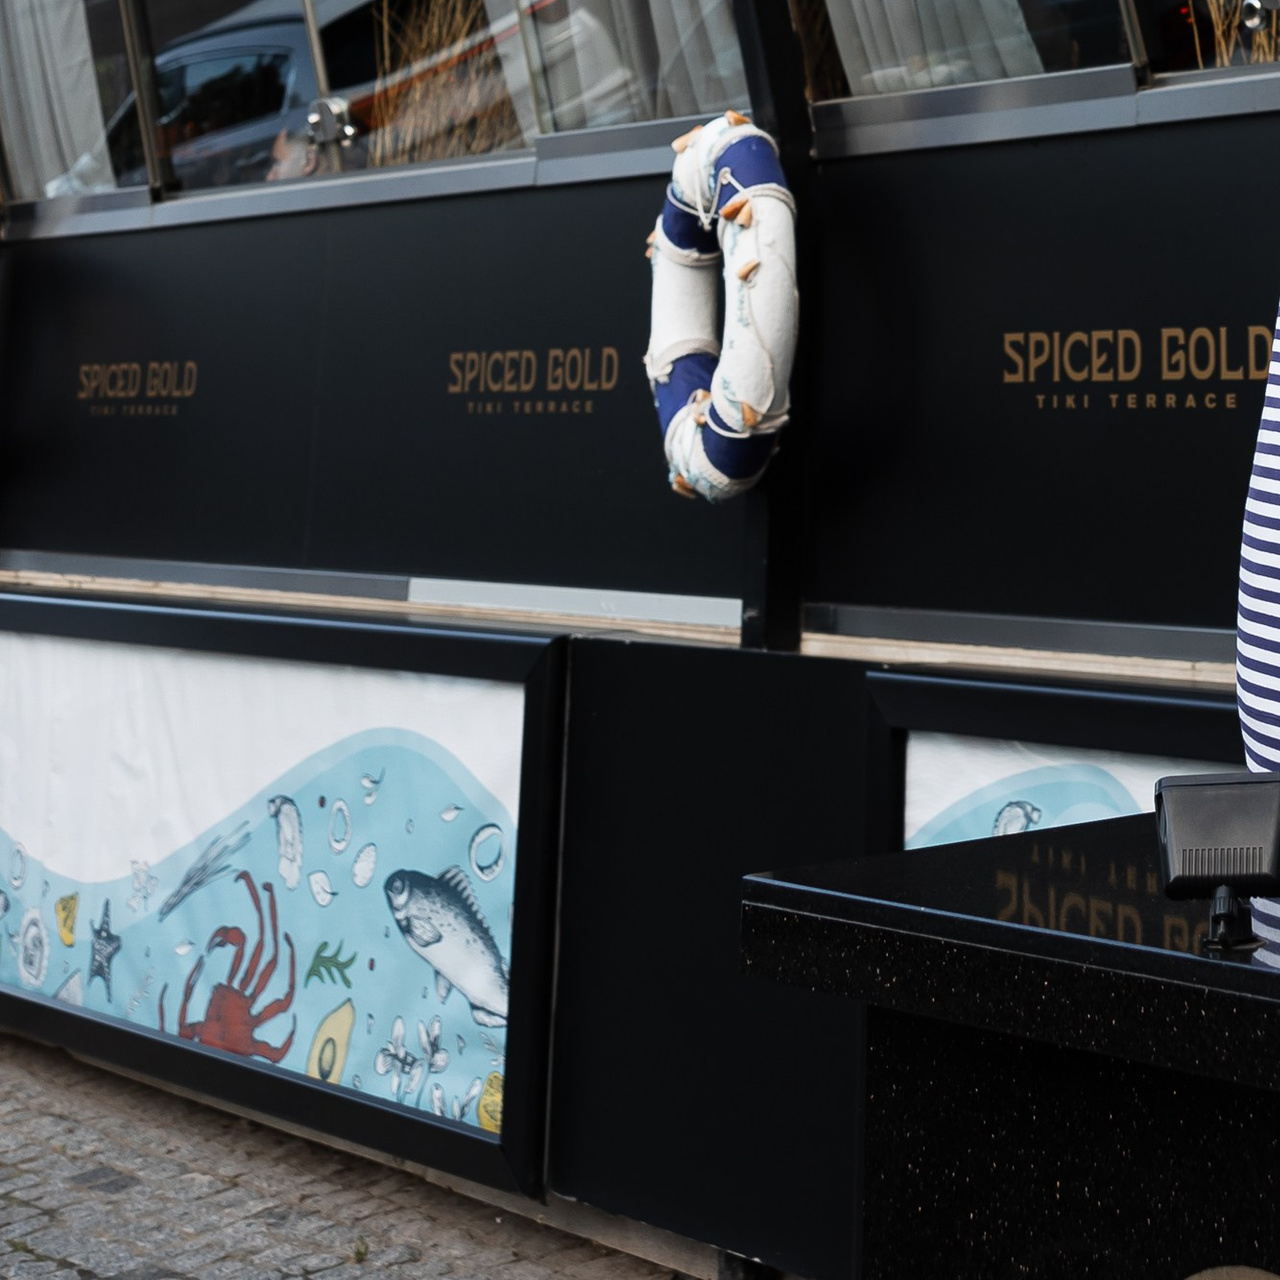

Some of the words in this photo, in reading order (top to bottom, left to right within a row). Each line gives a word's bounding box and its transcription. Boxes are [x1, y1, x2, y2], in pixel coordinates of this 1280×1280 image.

[448, 350, 537, 394] SPICED
[547, 346, 619, 391] GOLD
[1002, 329, 1142, 383] SPICED
[1161, 326, 1273, 381] GOLD
[77, 364, 142, 398] SPICED
[146, 360, 198, 397] GOLD
[514, 400, 593, 414] TERRACE
[1036, 394, 1089, 409] TIKI
[1110, 393, 1237, 409] TERRACE
